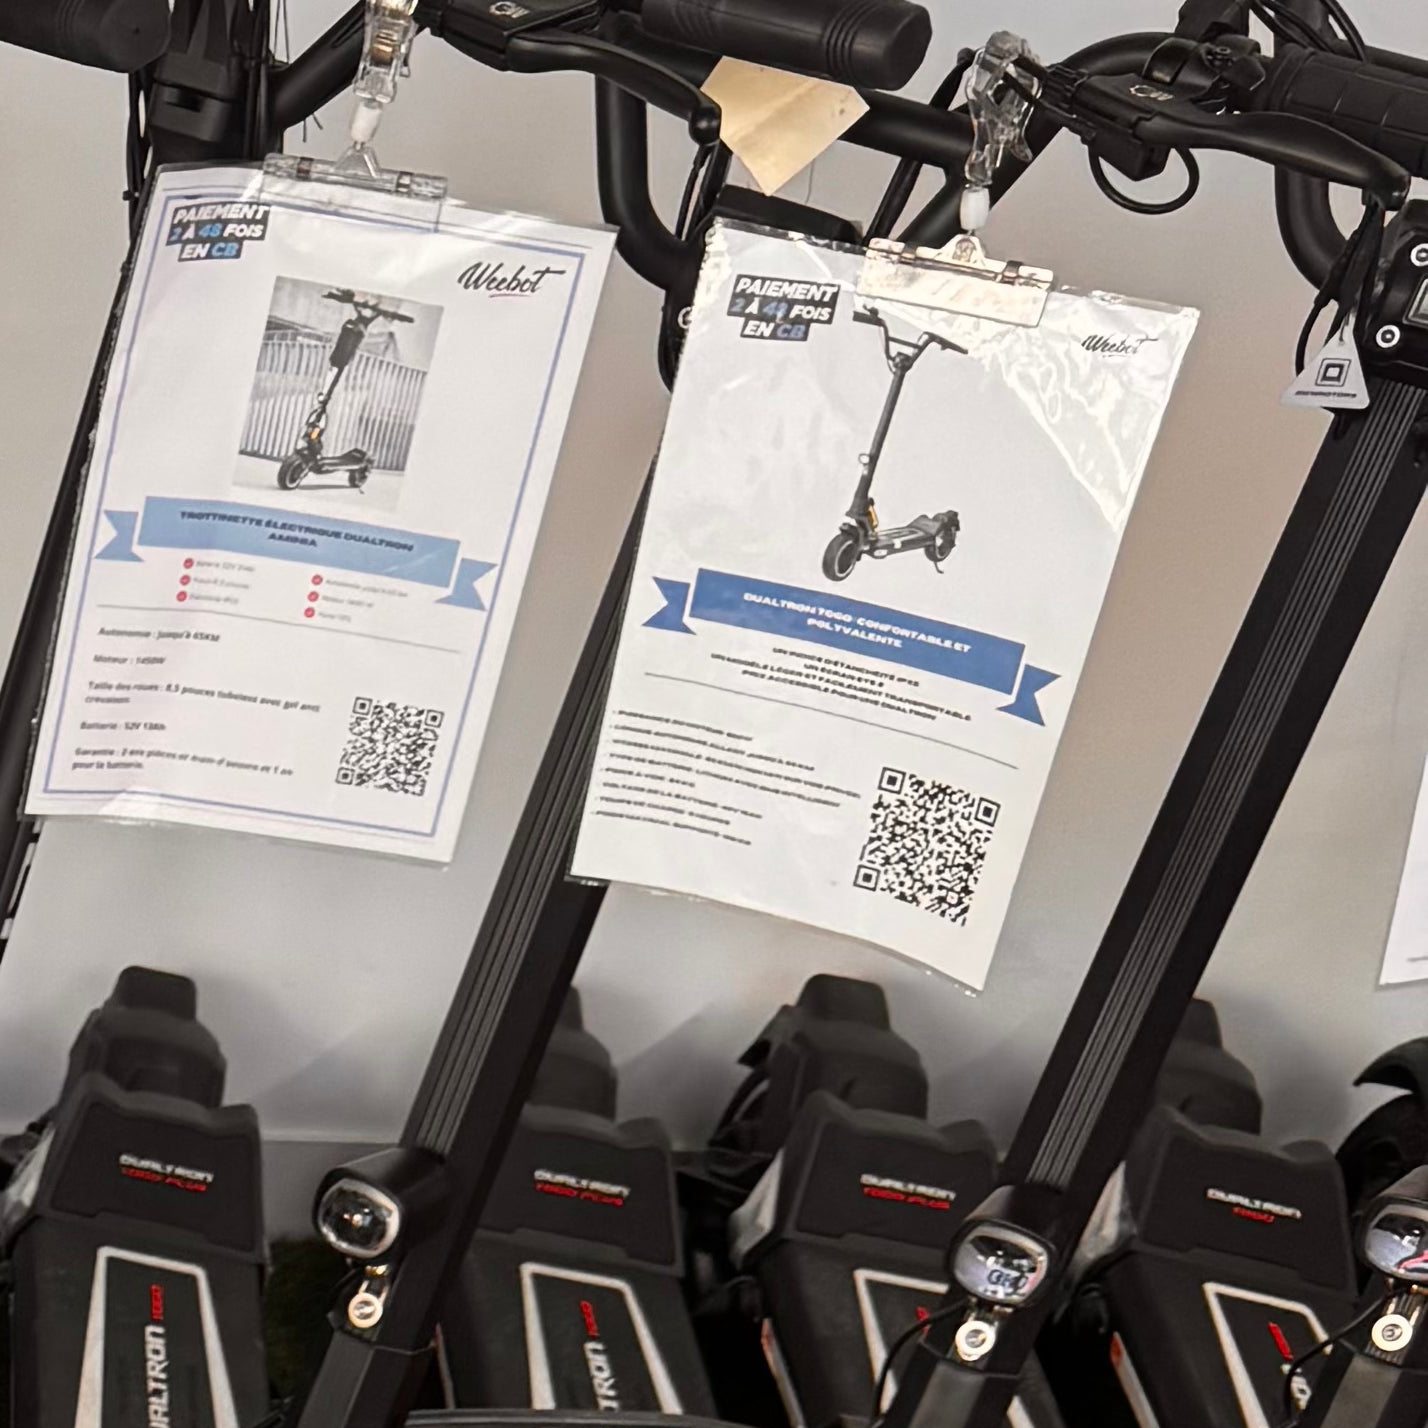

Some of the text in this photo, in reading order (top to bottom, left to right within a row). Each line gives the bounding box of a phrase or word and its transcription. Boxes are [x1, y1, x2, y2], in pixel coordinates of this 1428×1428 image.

[173, 202, 269, 223] PAIEMENT
[172, 223, 264, 242] 2 À 48 FOIS
[181, 242, 238, 259] EN CB
[457, 262, 566, 294] Weebot
[735, 278, 838, 302] PAIEMENT
[731, 298, 745, 312] 2
[744, 297, 760, 314] À
[789, 305, 832, 321] FOIS
[742, 321, 806, 339] EN CB
[1081, 333, 1159, 353] Weebot
[180, 510, 414, 552] TROTTINETTE ÉLECTRIQUE DUALTRON
[743, 592, 971, 652] DUALTRON TOGO CONFORTABLE ET
[806, 617, 902, 647] POLYVALENTE
[119, 1153, 214, 1183] DUALTRON
[534, 1169, 631, 1198] DUALTRON
[860, 1173, 956, 1201] DUALTRON
[1207, 1188, 1302, 1218] DUALTRON
